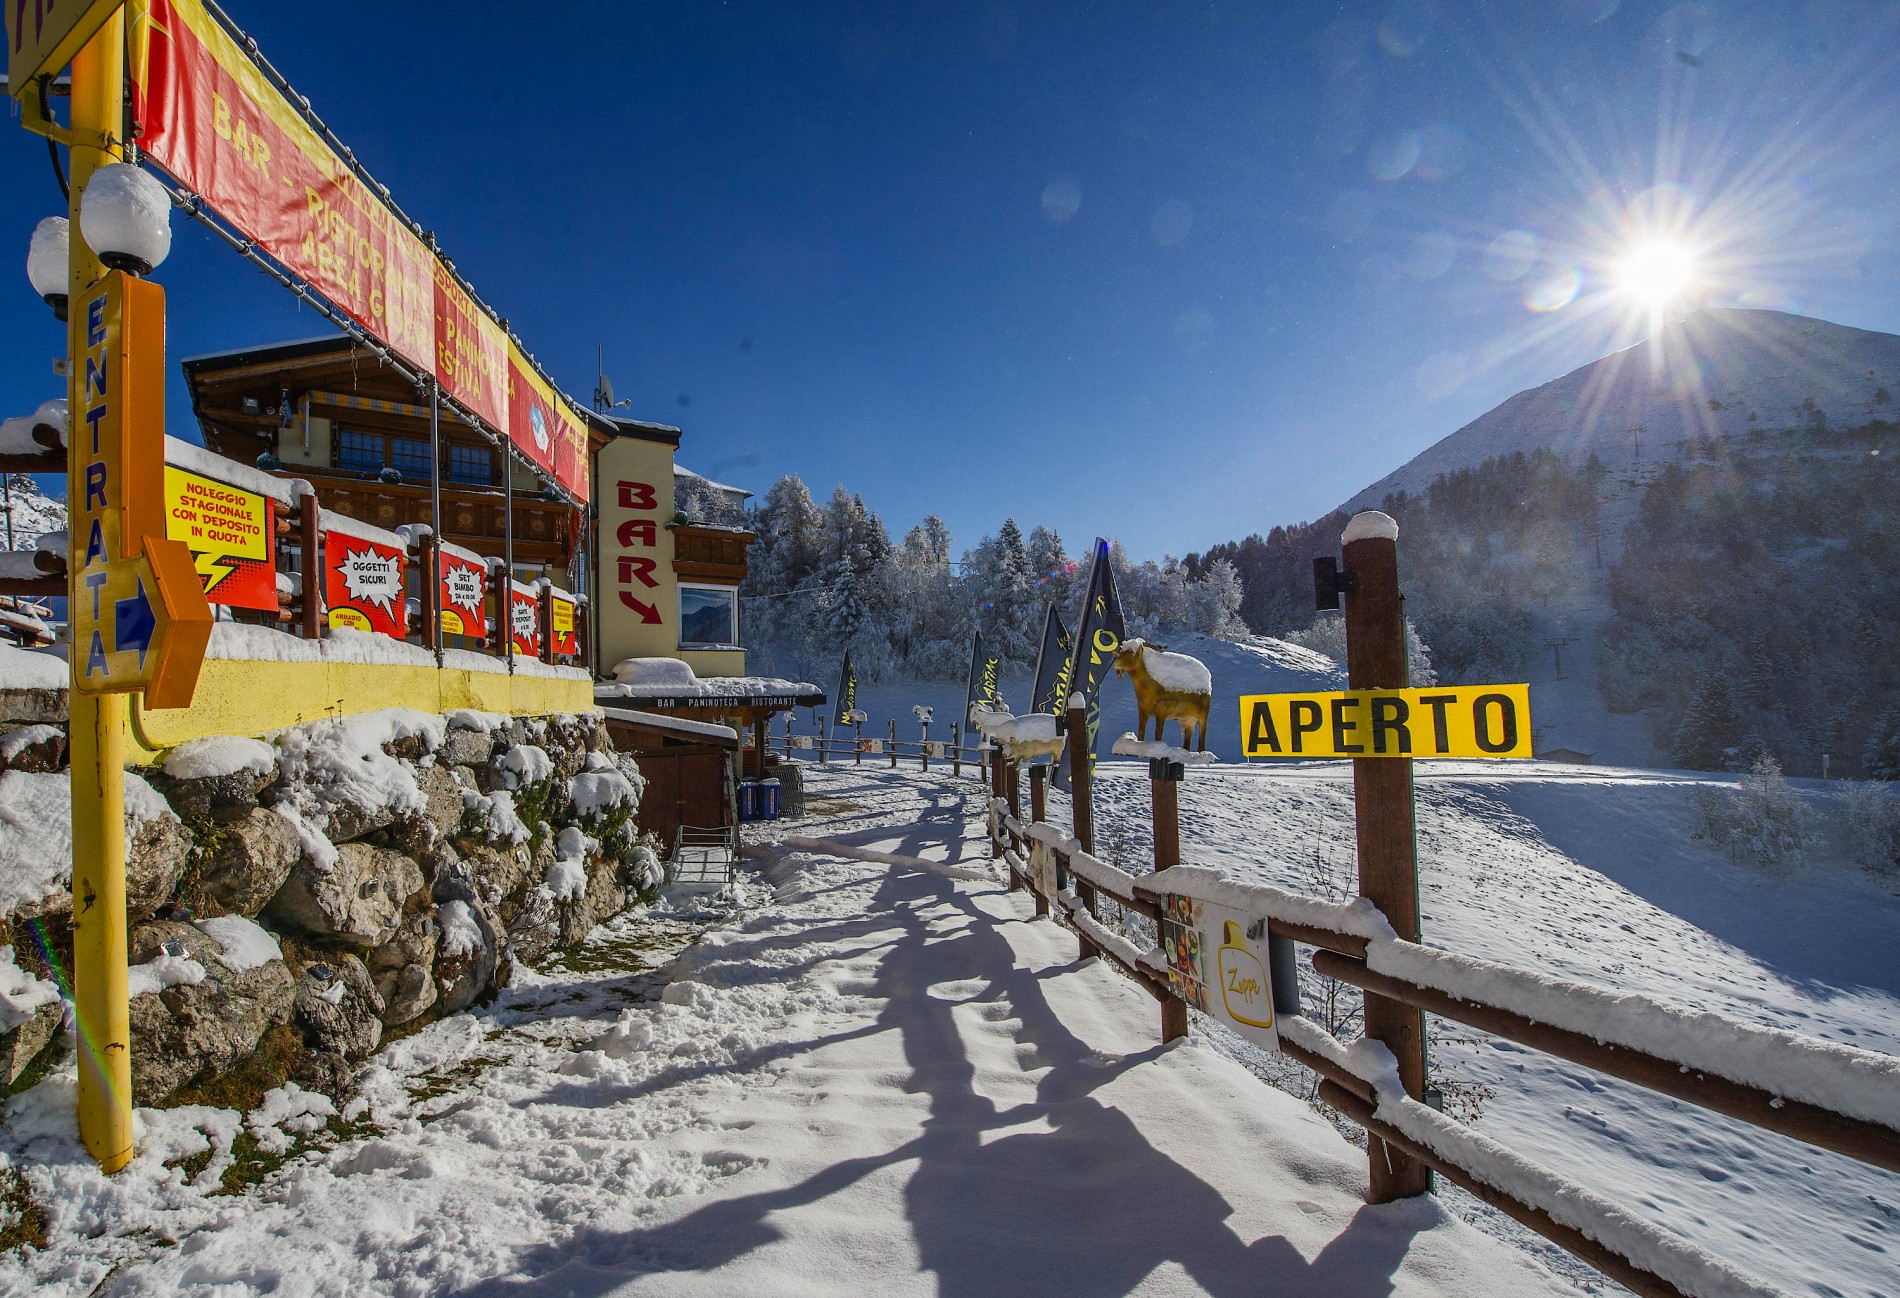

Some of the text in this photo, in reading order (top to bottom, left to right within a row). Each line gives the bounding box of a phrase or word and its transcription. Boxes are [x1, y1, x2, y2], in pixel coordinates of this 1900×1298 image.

[213, 91, 271, 179] BAR
[305, 186, 431, 318] RISTORANTE
[446, 317, 516, 401] PANINOTECA
[302, 231, 361, 302] AREA
[438, 340, 481, 401] ESTIVA
[85, 292, 109, 678] ENTRATA
[186, 482, 246, 506] NOLEGGIO
[180, 495, 253, 521] STAGIONALE
[172, 508, 260, 535] CON DEPOSITO
[191, 526, 246, 546] IN QUOTA
[616, 480, 660, 588] BAR
[352, 562, 390, 572] OGGETTI
[458, 573, 471, 582] SET
[359, 575, 387, 584] SICURI
[454, 583, 474, 592] BIMBO
[335, 613, 362, 622] ARMADIO
[657, 697, 797, 707] BAR PANINOTECA RISTORANTE
[1247, 693, 1518, 754] APERTO
